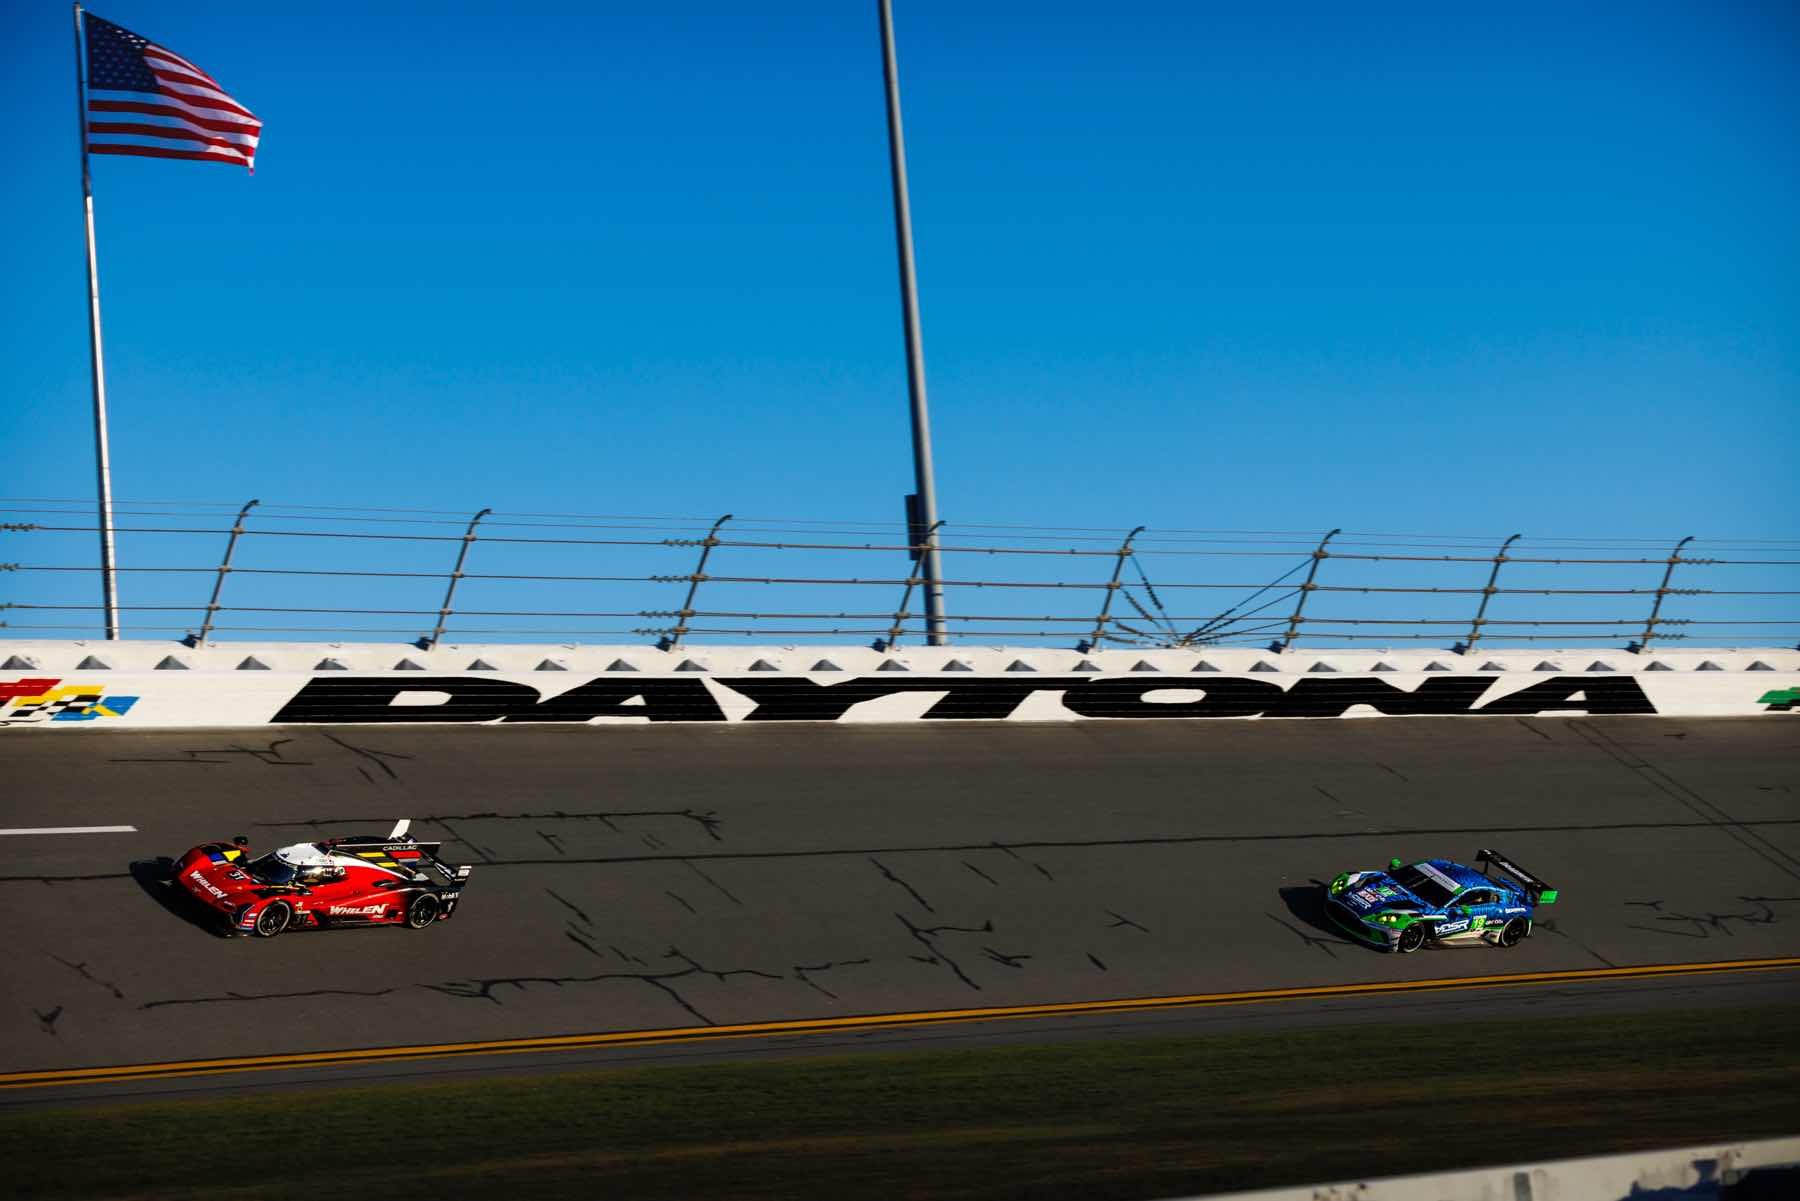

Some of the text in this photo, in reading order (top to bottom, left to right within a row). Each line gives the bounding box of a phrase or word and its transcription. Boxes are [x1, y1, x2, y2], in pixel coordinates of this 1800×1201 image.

[269, 676, 1658, 723] DAYTONA
[189, 870, 229, 899] WHELEN
[229, 870, 245, 881] 31
[329, 903, 390, 915] WHELEN
